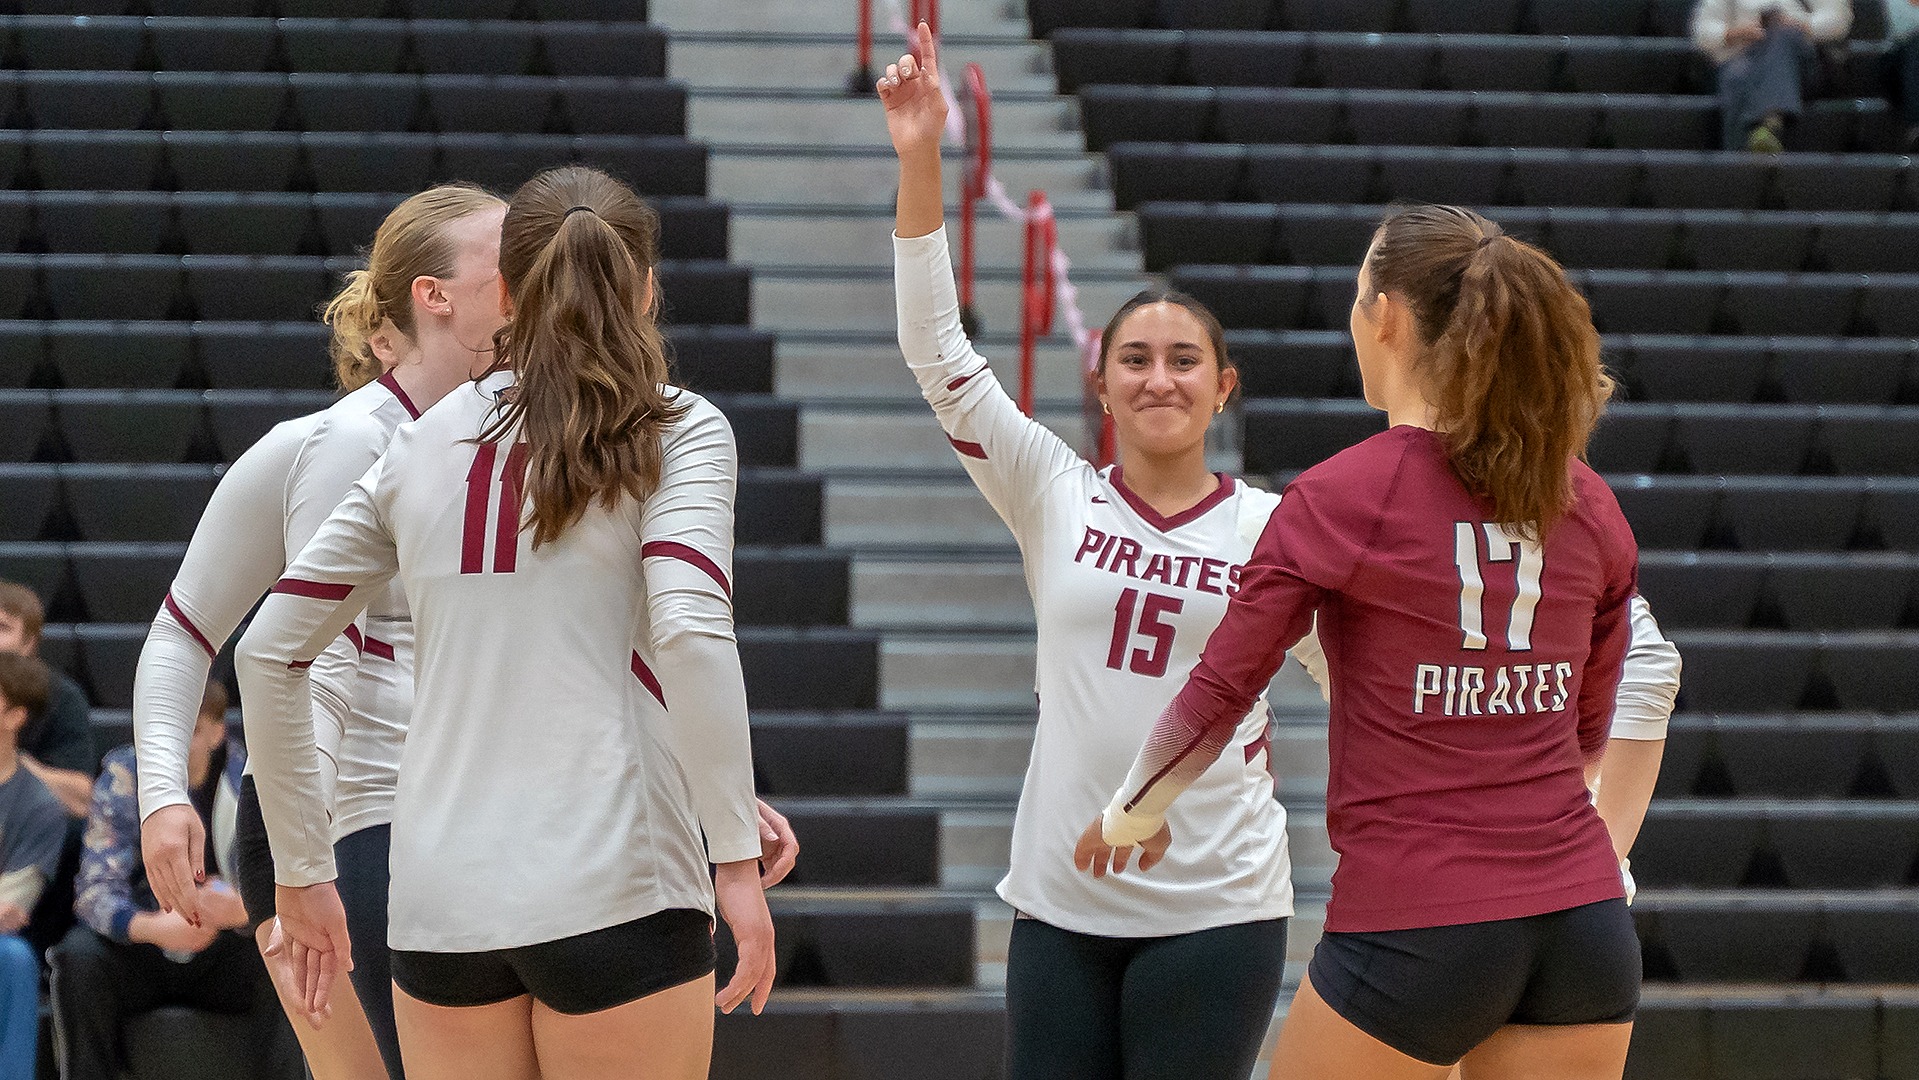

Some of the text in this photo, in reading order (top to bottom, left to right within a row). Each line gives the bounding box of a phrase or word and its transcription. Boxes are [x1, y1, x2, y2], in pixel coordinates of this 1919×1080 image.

[460, 442, 528, 573] 11
[1074, 525, 1241, 596] PIRATES
[1454, 521, 1544, 651] 17
[1106, 587, 1184, 678] 15
[1414, 661, 1573, 716] PIRATES
